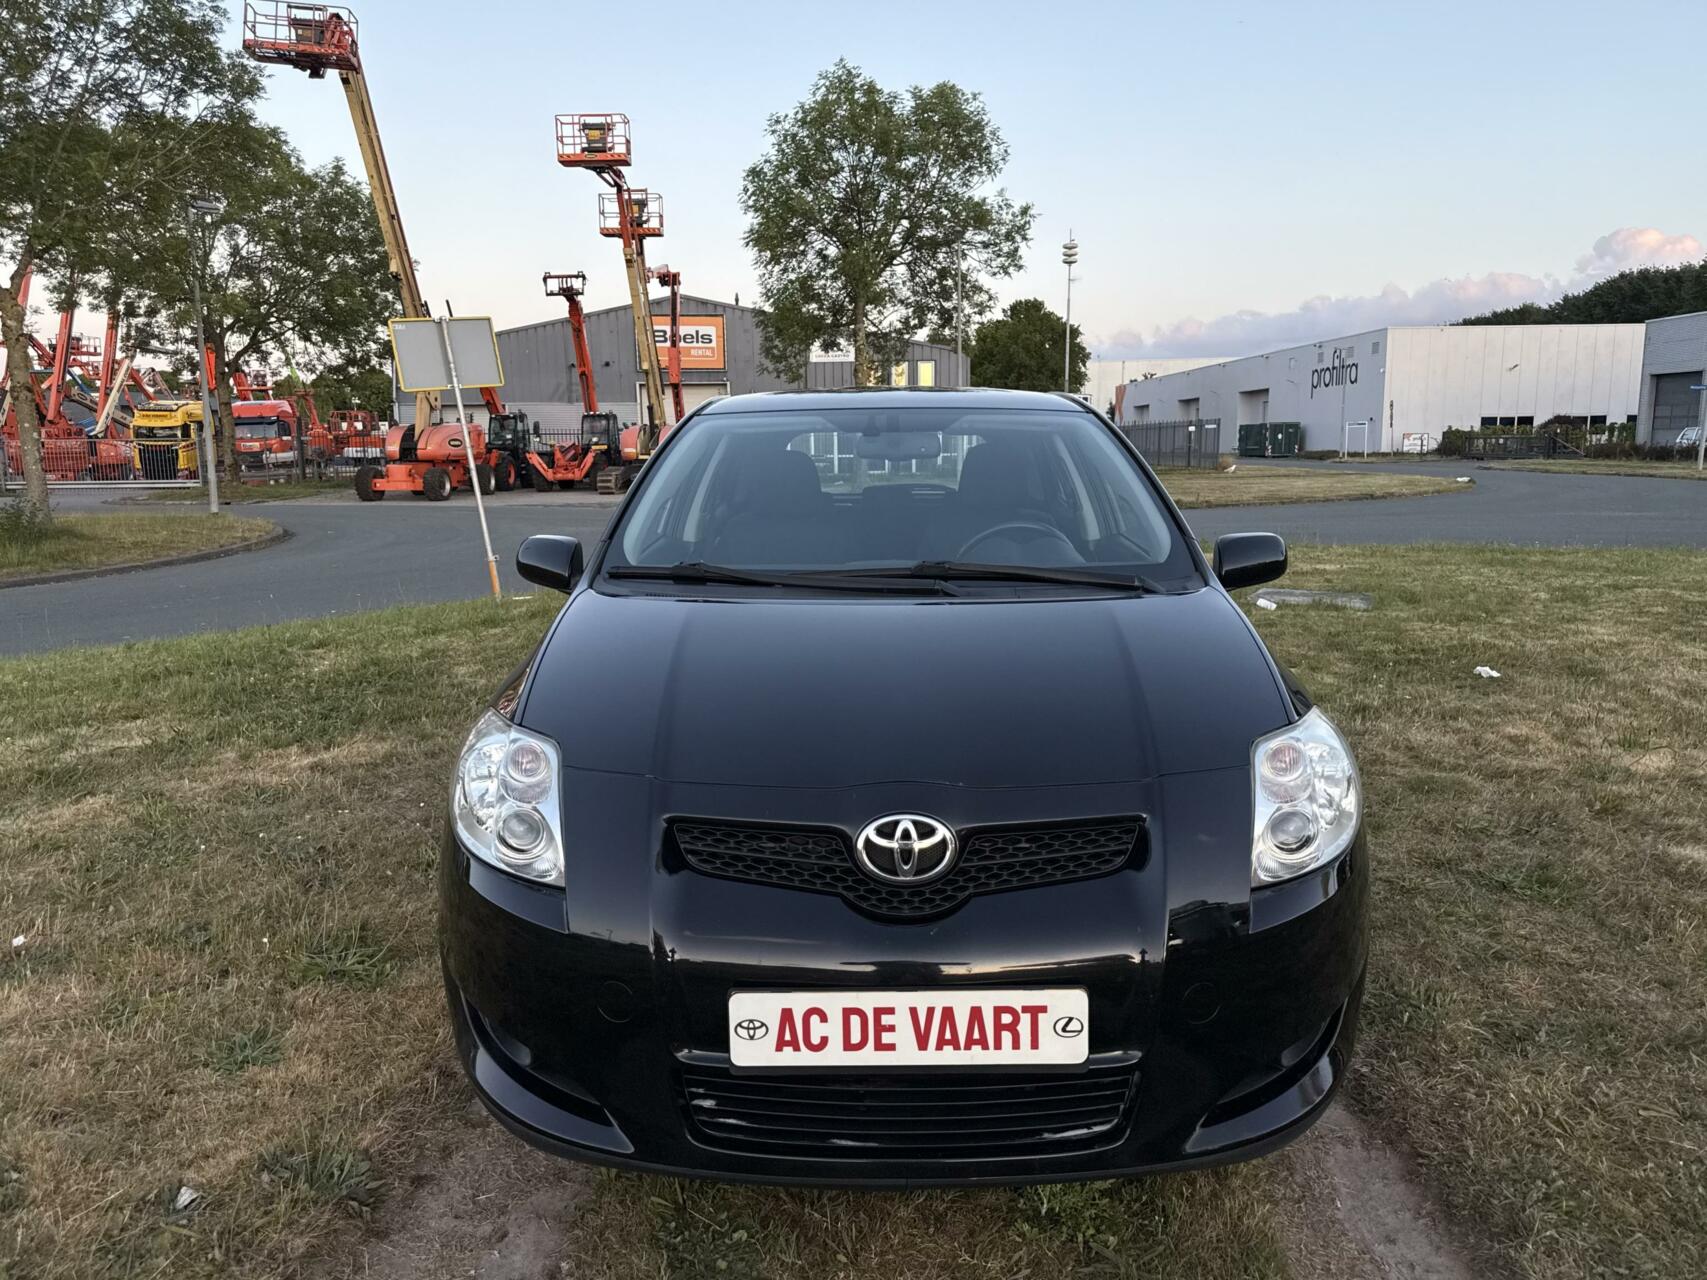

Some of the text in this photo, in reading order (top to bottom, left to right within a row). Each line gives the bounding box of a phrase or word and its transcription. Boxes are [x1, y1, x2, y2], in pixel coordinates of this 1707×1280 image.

[654, 329, 713, 344] Bels
[690, 348, 713, 356] RENTAL
[1310, 348, 1359, 399] profiltra
[774, 1004, 1049, 1053] AC DE VAART
